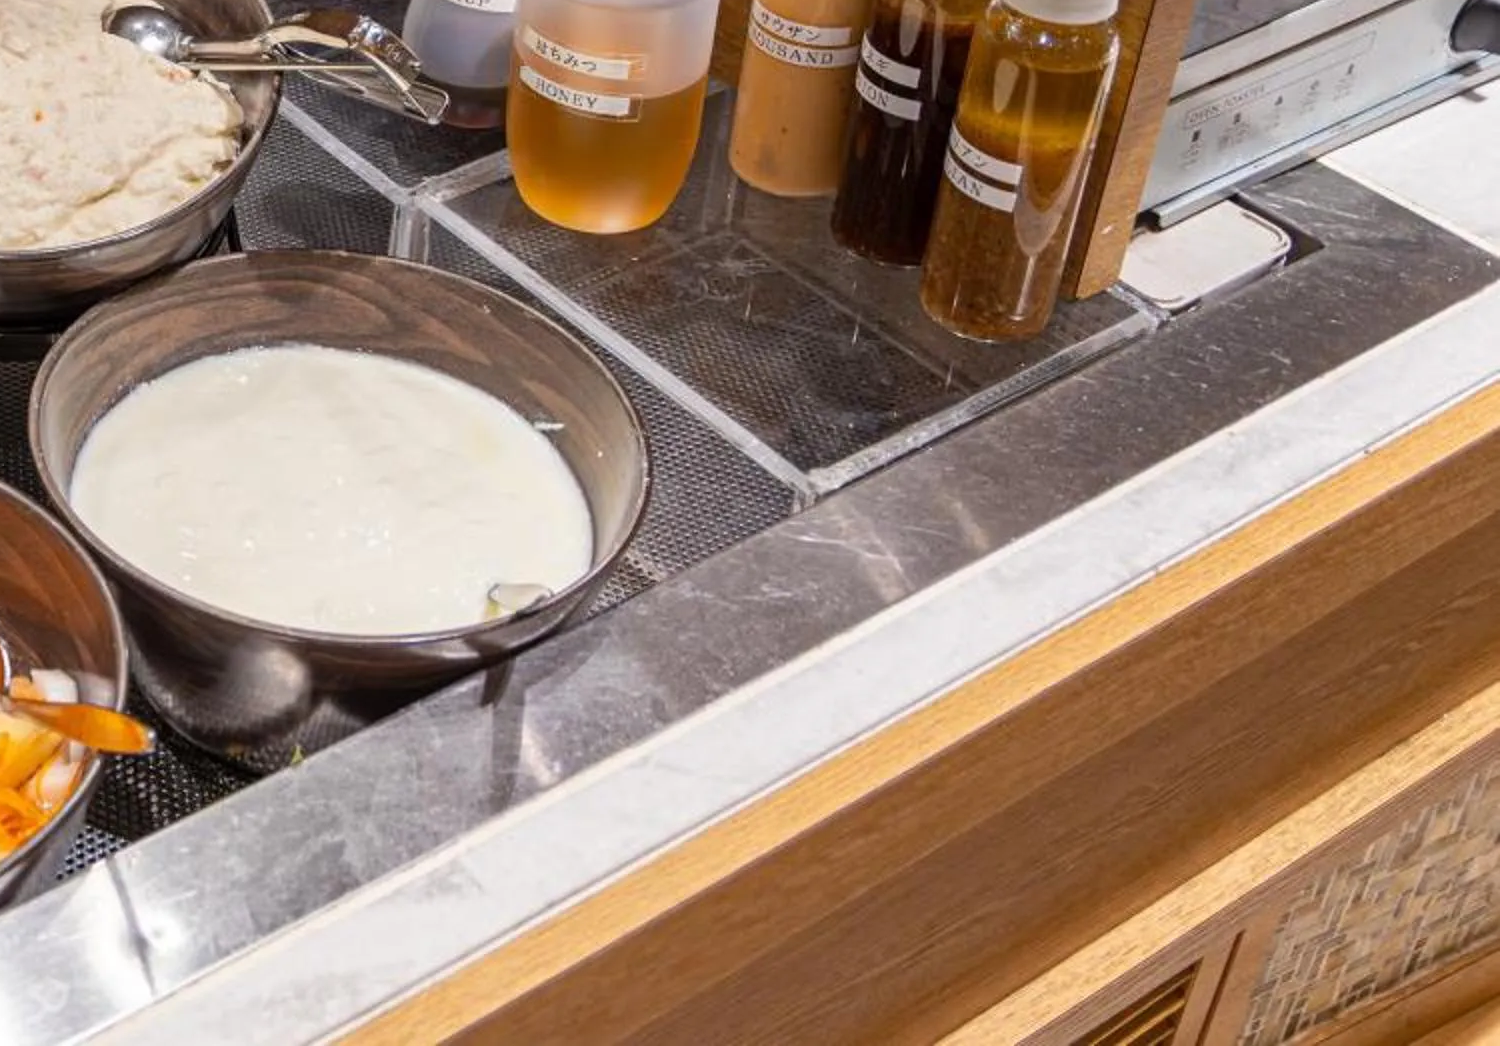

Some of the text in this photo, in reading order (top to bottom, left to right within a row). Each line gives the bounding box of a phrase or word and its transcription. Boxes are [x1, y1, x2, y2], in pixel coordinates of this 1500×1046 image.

[535, 37, 597, 72] はちみつ
[754, 28, 833, 65] OUSAND
[535, 77, 597, 108] HONEY
